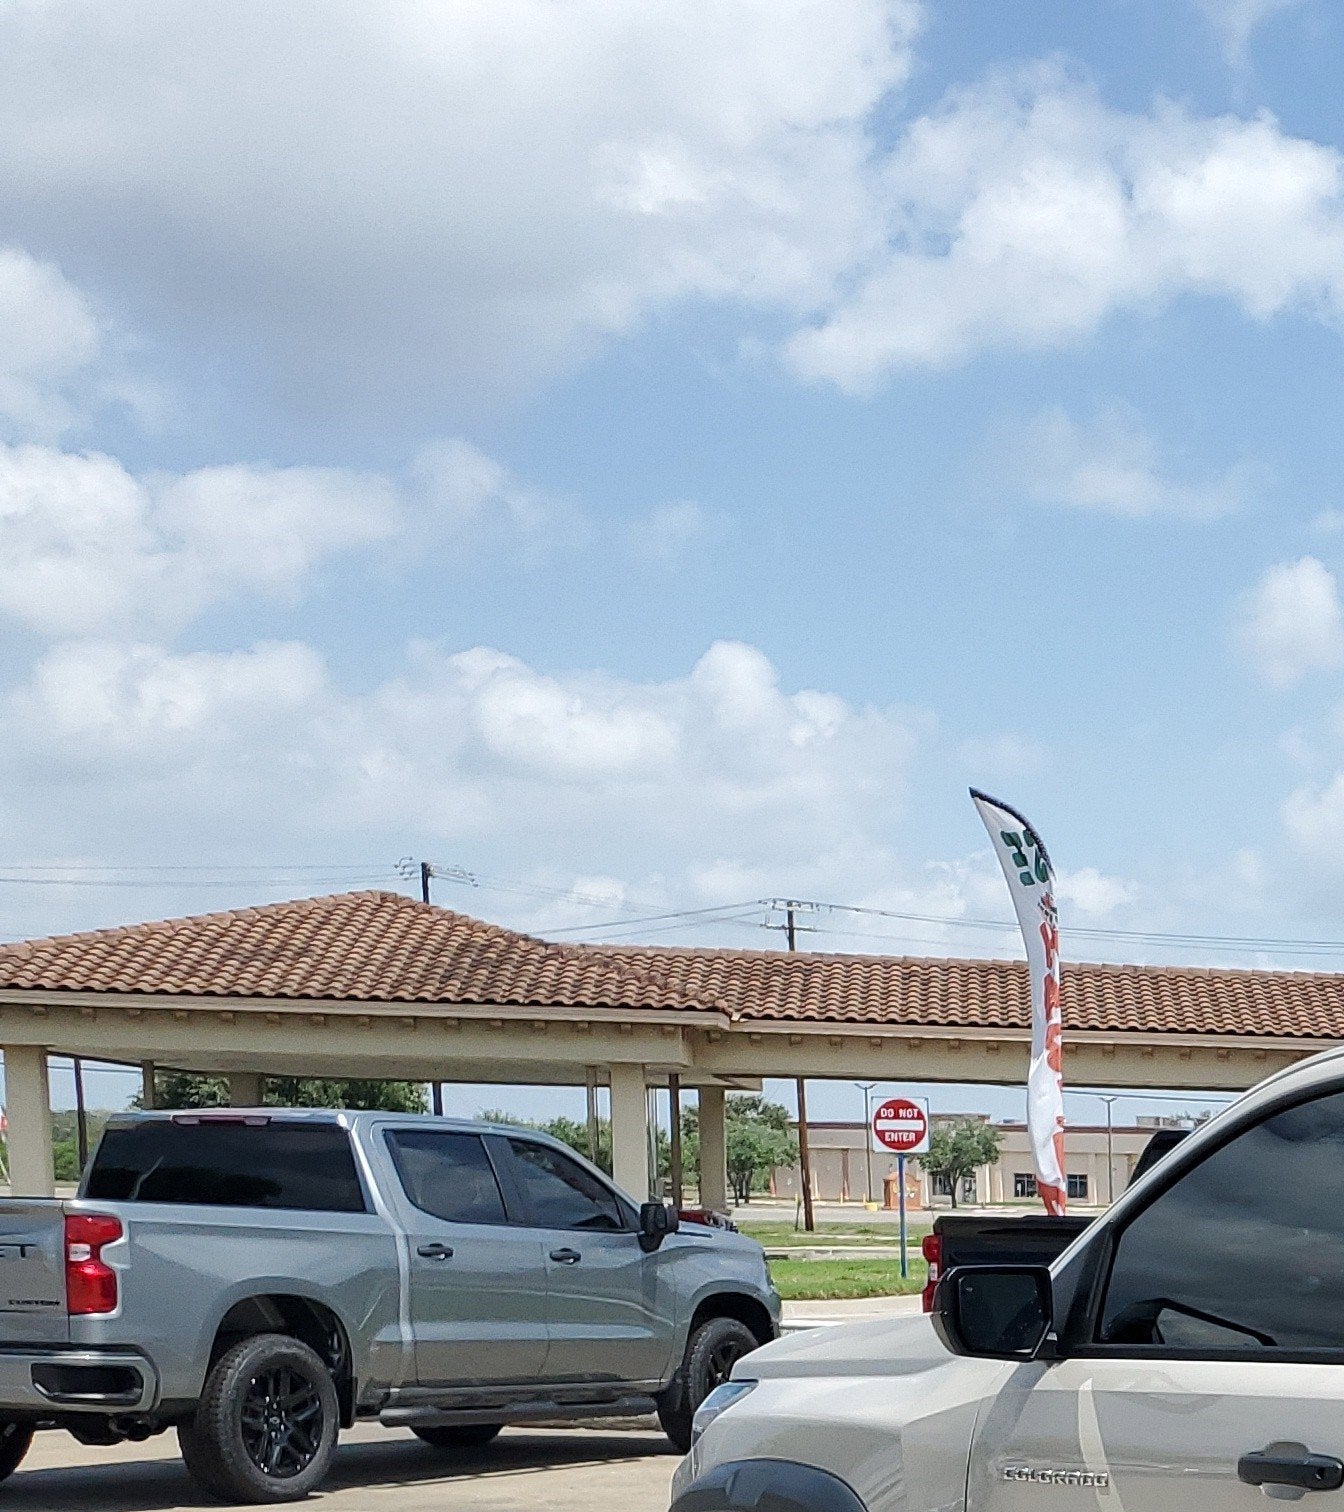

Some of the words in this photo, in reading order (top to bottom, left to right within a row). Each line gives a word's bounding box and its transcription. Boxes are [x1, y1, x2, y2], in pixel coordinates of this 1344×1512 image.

[880, 1108, 895, 1118] DO
[899, 1108, 919, 1118] NOT
[884, 1131, 916, 1143] ENTER
[1002, 1466, 1109, 1488] COLORADO
